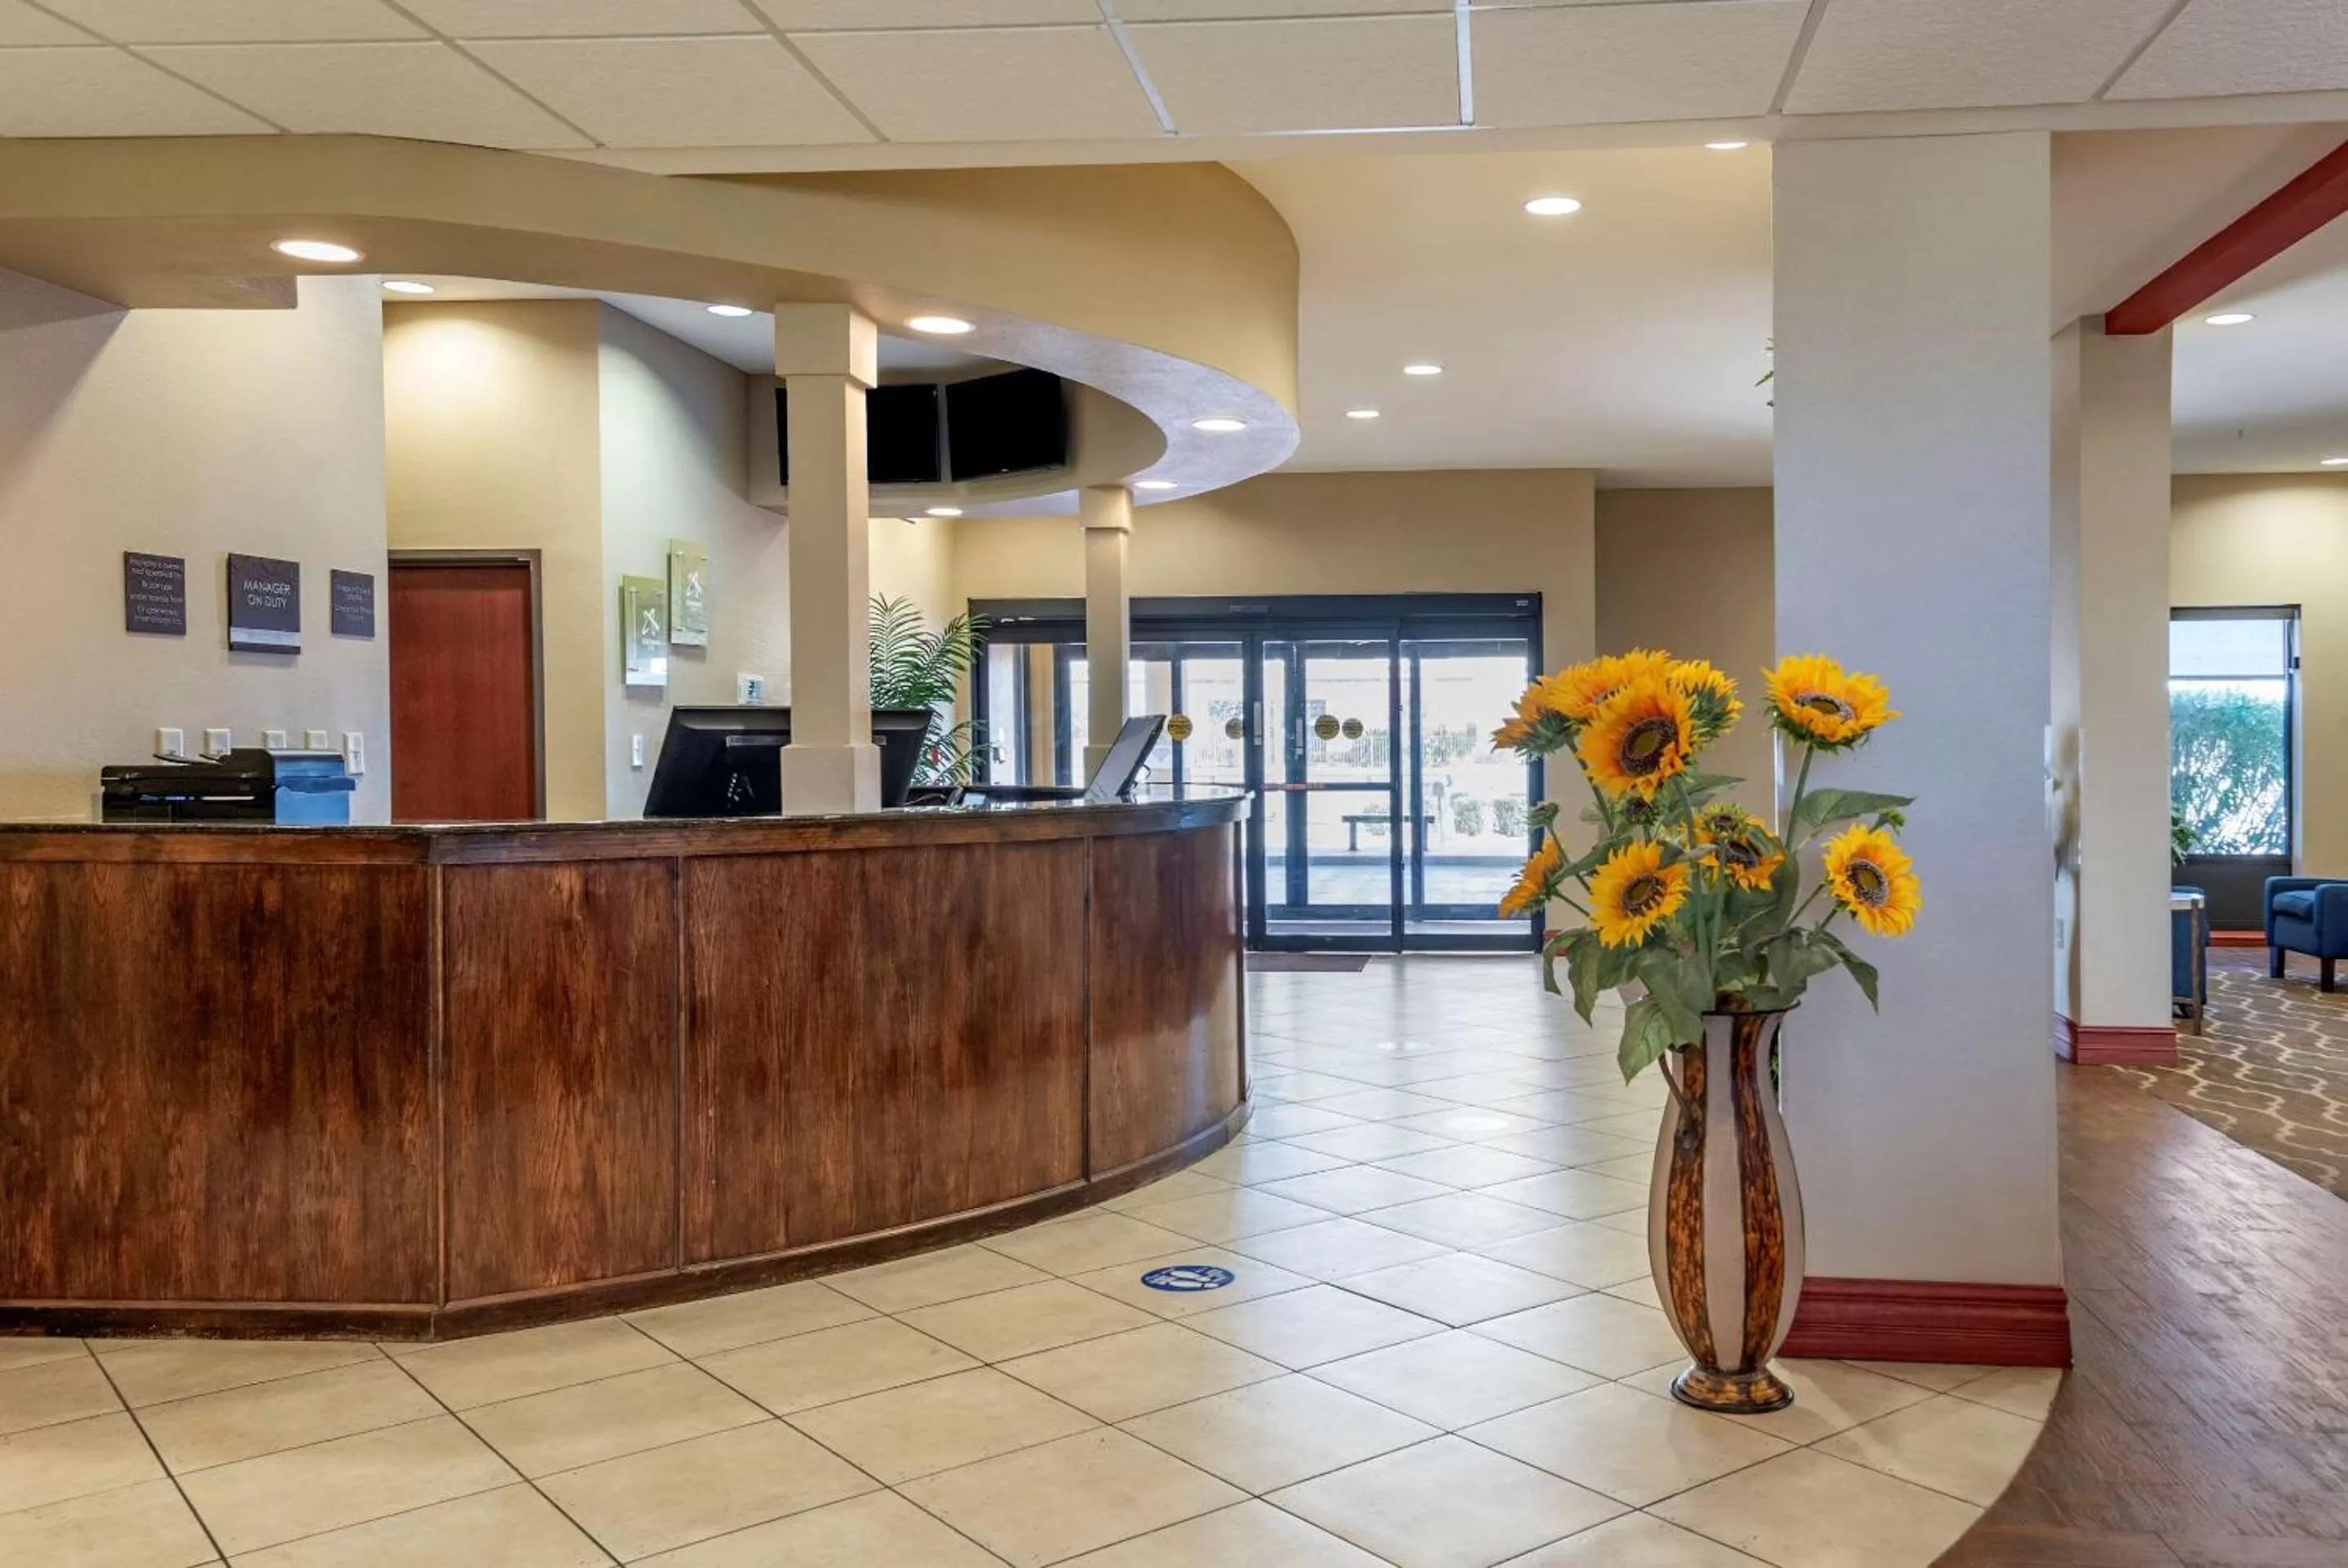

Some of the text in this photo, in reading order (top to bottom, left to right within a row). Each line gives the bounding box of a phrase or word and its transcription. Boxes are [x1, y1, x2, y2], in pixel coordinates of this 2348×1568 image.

[244, 580, 290, 595] MANAGER
[247, 594, 287, 610] ON DUTY
